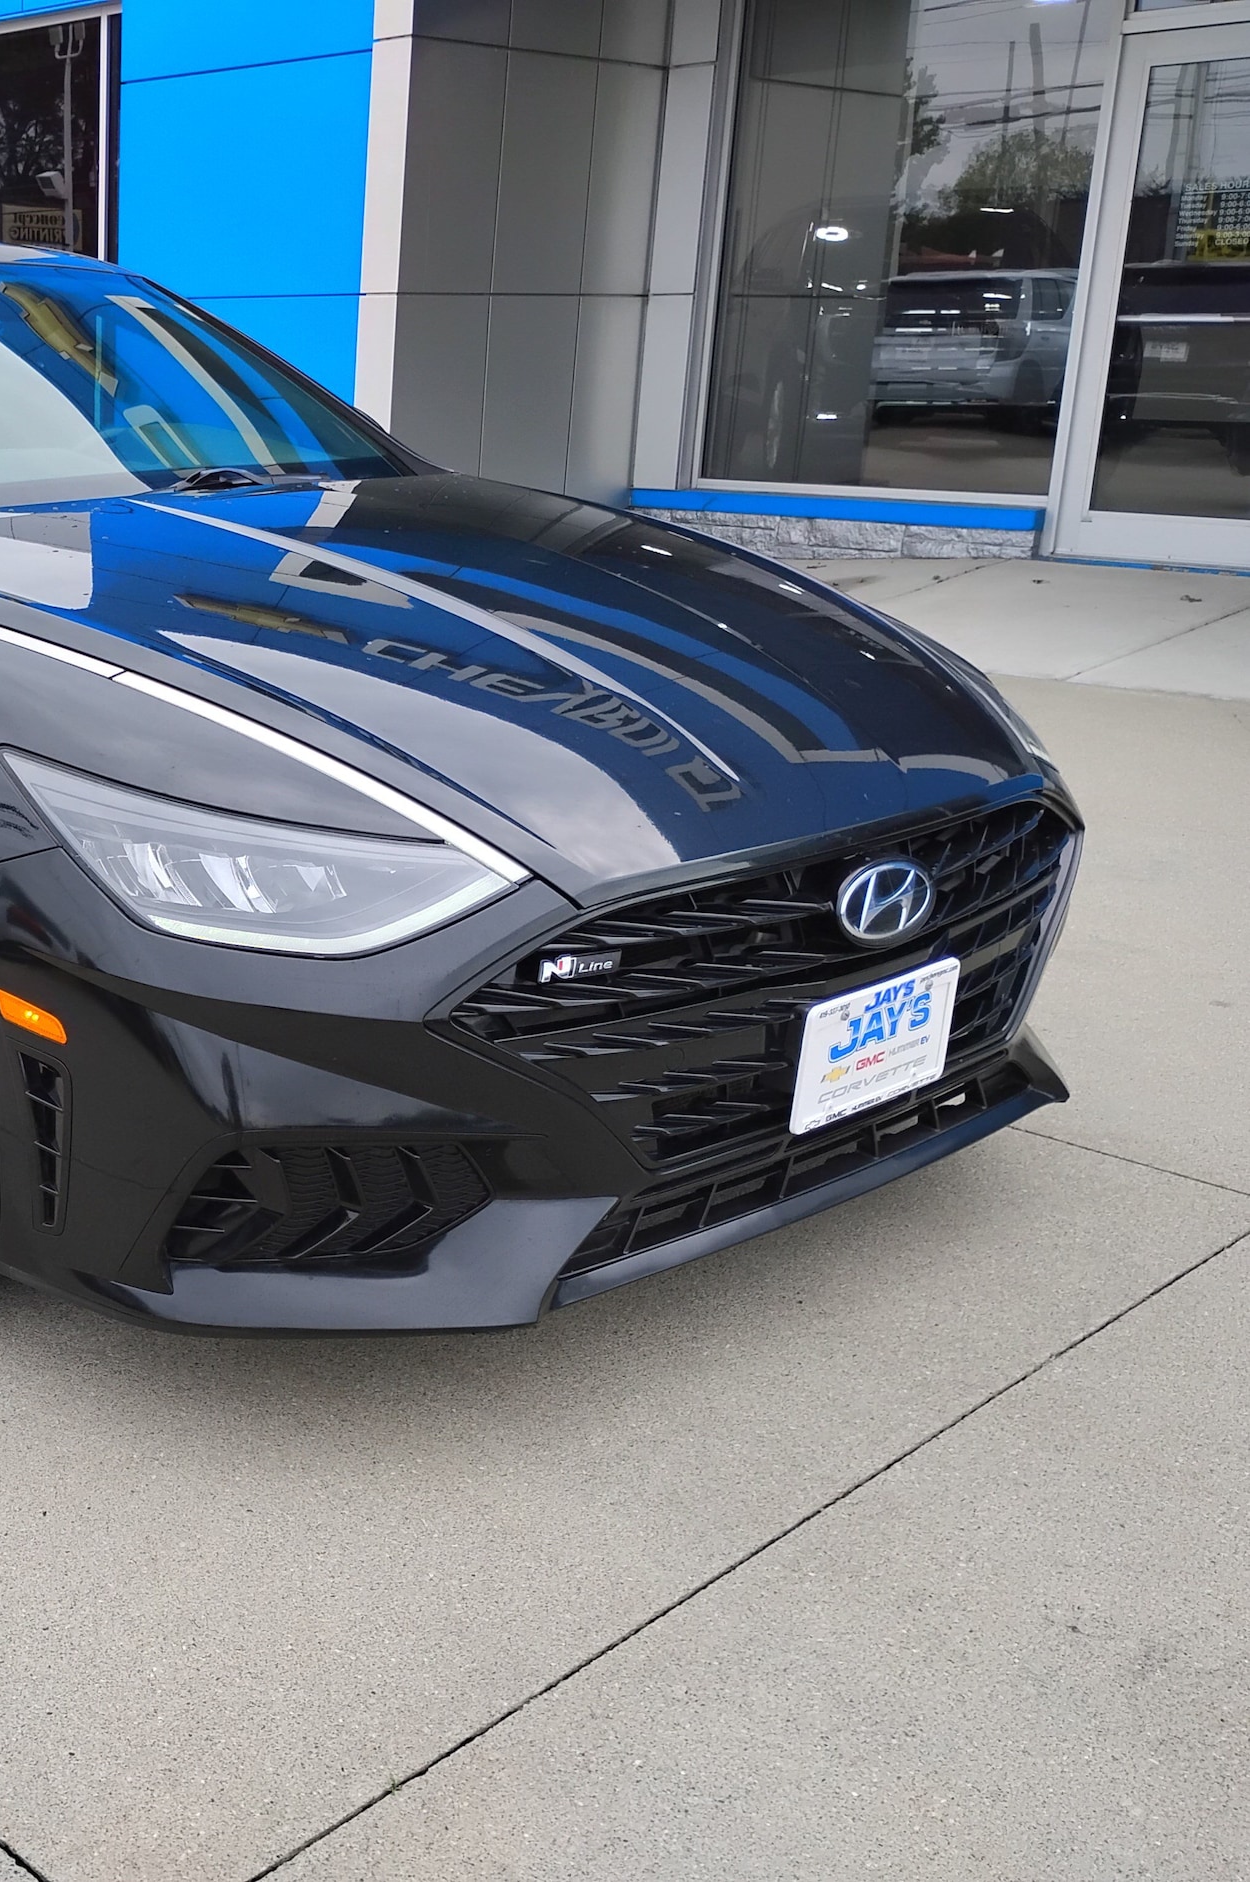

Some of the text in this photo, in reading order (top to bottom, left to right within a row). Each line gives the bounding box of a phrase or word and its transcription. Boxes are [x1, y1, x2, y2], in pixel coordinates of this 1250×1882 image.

[1185, 180, 1250, 191] SALES HOUR
[1215, 238, 1249, 246] CLOSED
[579, 960, 613, 973] Line
[864, 978, 916, 1014] JAY'S
[827, 991, 931, 1064] JAY'S
[855, 1051, 886, 1072] GMC
[920, 1035, 930, 1045] EV
[817, 1055, 927, 1104] CORVETTE
[825, 1109, 847, 1122] GMC
